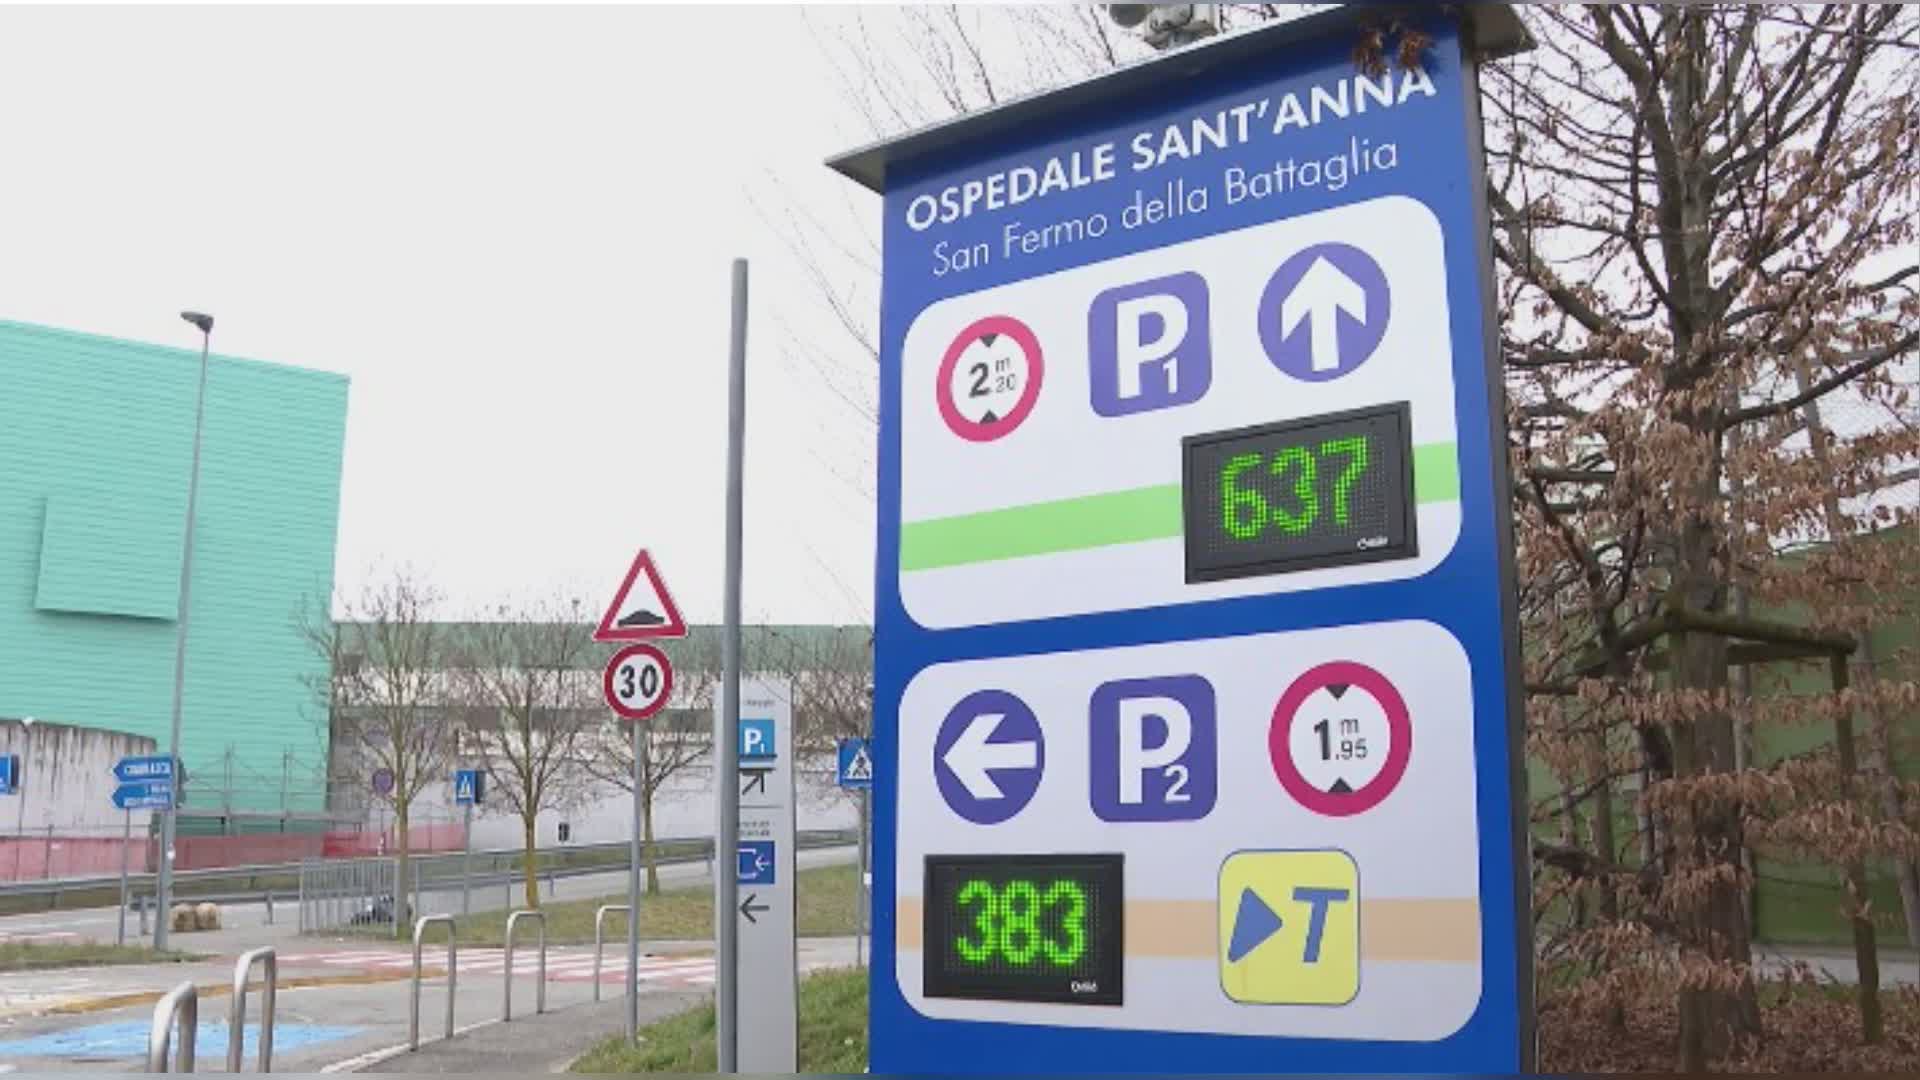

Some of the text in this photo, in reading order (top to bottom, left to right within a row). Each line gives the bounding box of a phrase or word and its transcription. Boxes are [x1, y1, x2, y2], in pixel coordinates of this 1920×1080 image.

[905, 68, 1437, 232] OSPEDALE SANT'ANNA
[932, 135, 1398, 278] San Fermo della Battaglia
[1221, 435, 1368, 540] 637
[620, 664, 658, 699] 30
[957, 880, 1086, 966] 383
[1292, 887, 1349, 963] T
